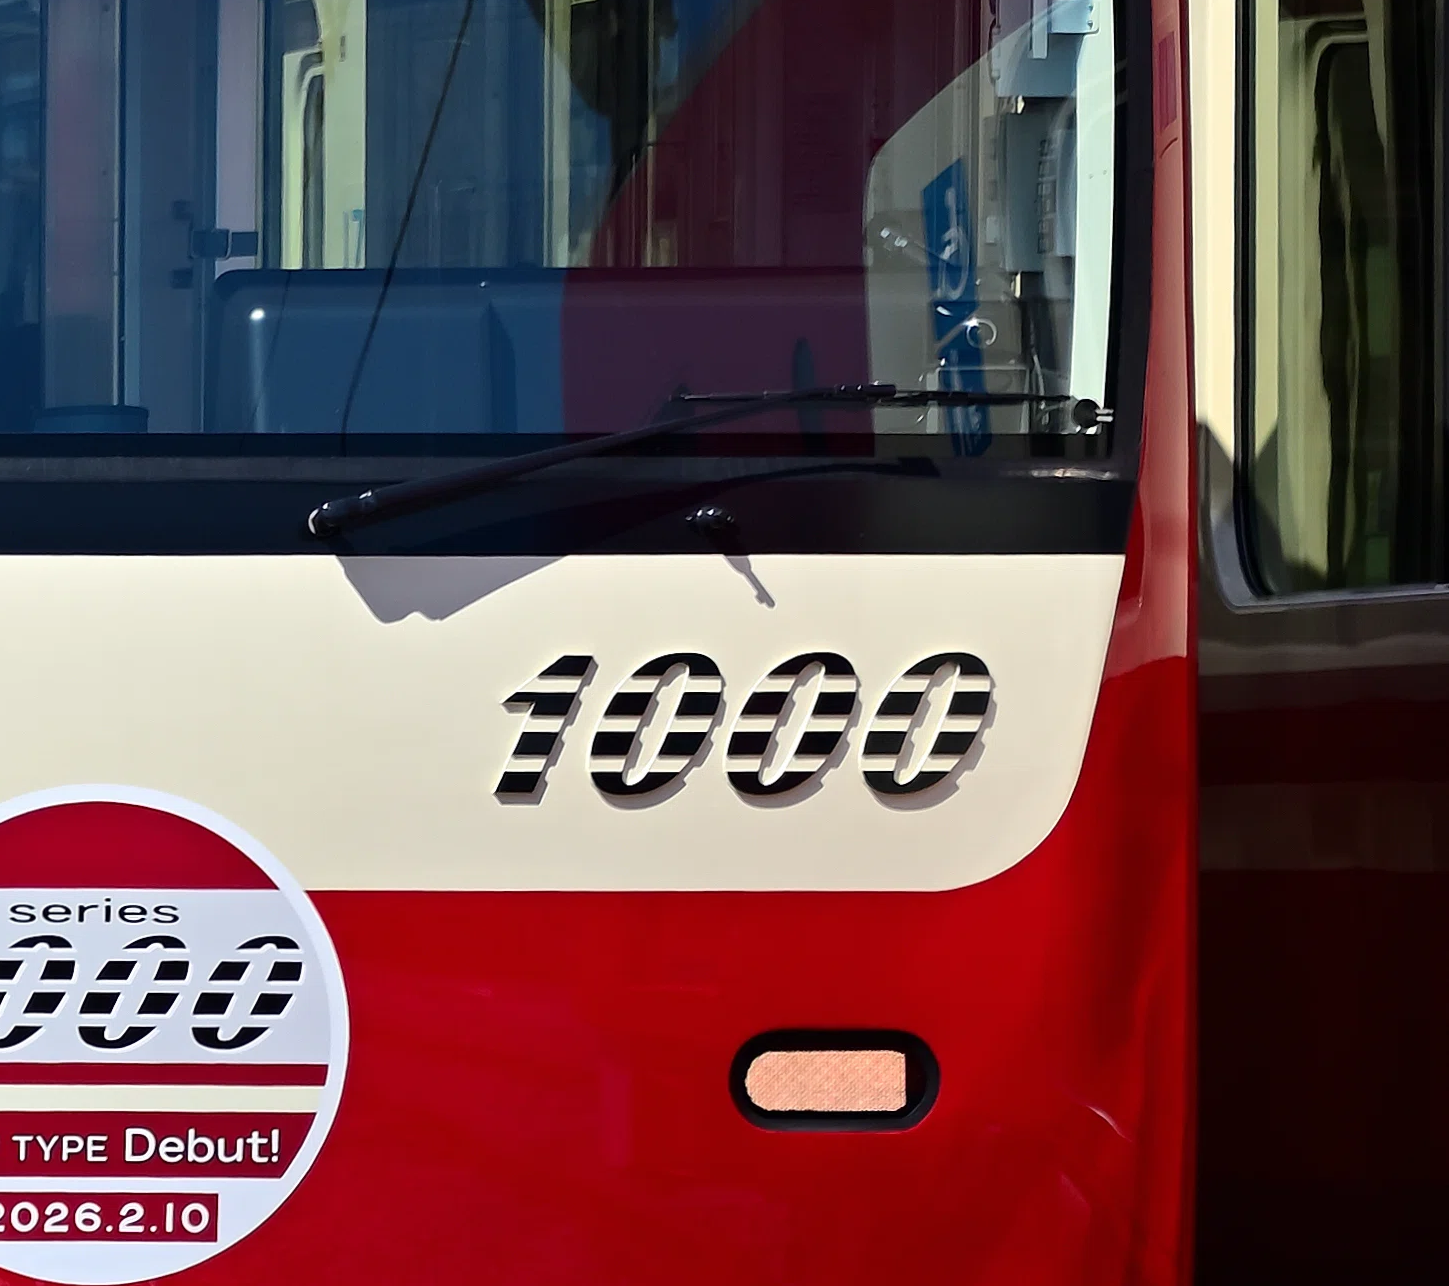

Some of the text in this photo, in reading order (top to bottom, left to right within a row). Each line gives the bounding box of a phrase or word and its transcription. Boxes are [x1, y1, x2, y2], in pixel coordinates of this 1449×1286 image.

[491, 651, 995, 805] 1000
[7, 897, 182, 924] series
[11, 1134, 109, 1163] TYPE
[122, 1127, 282, 1164] Debut!
